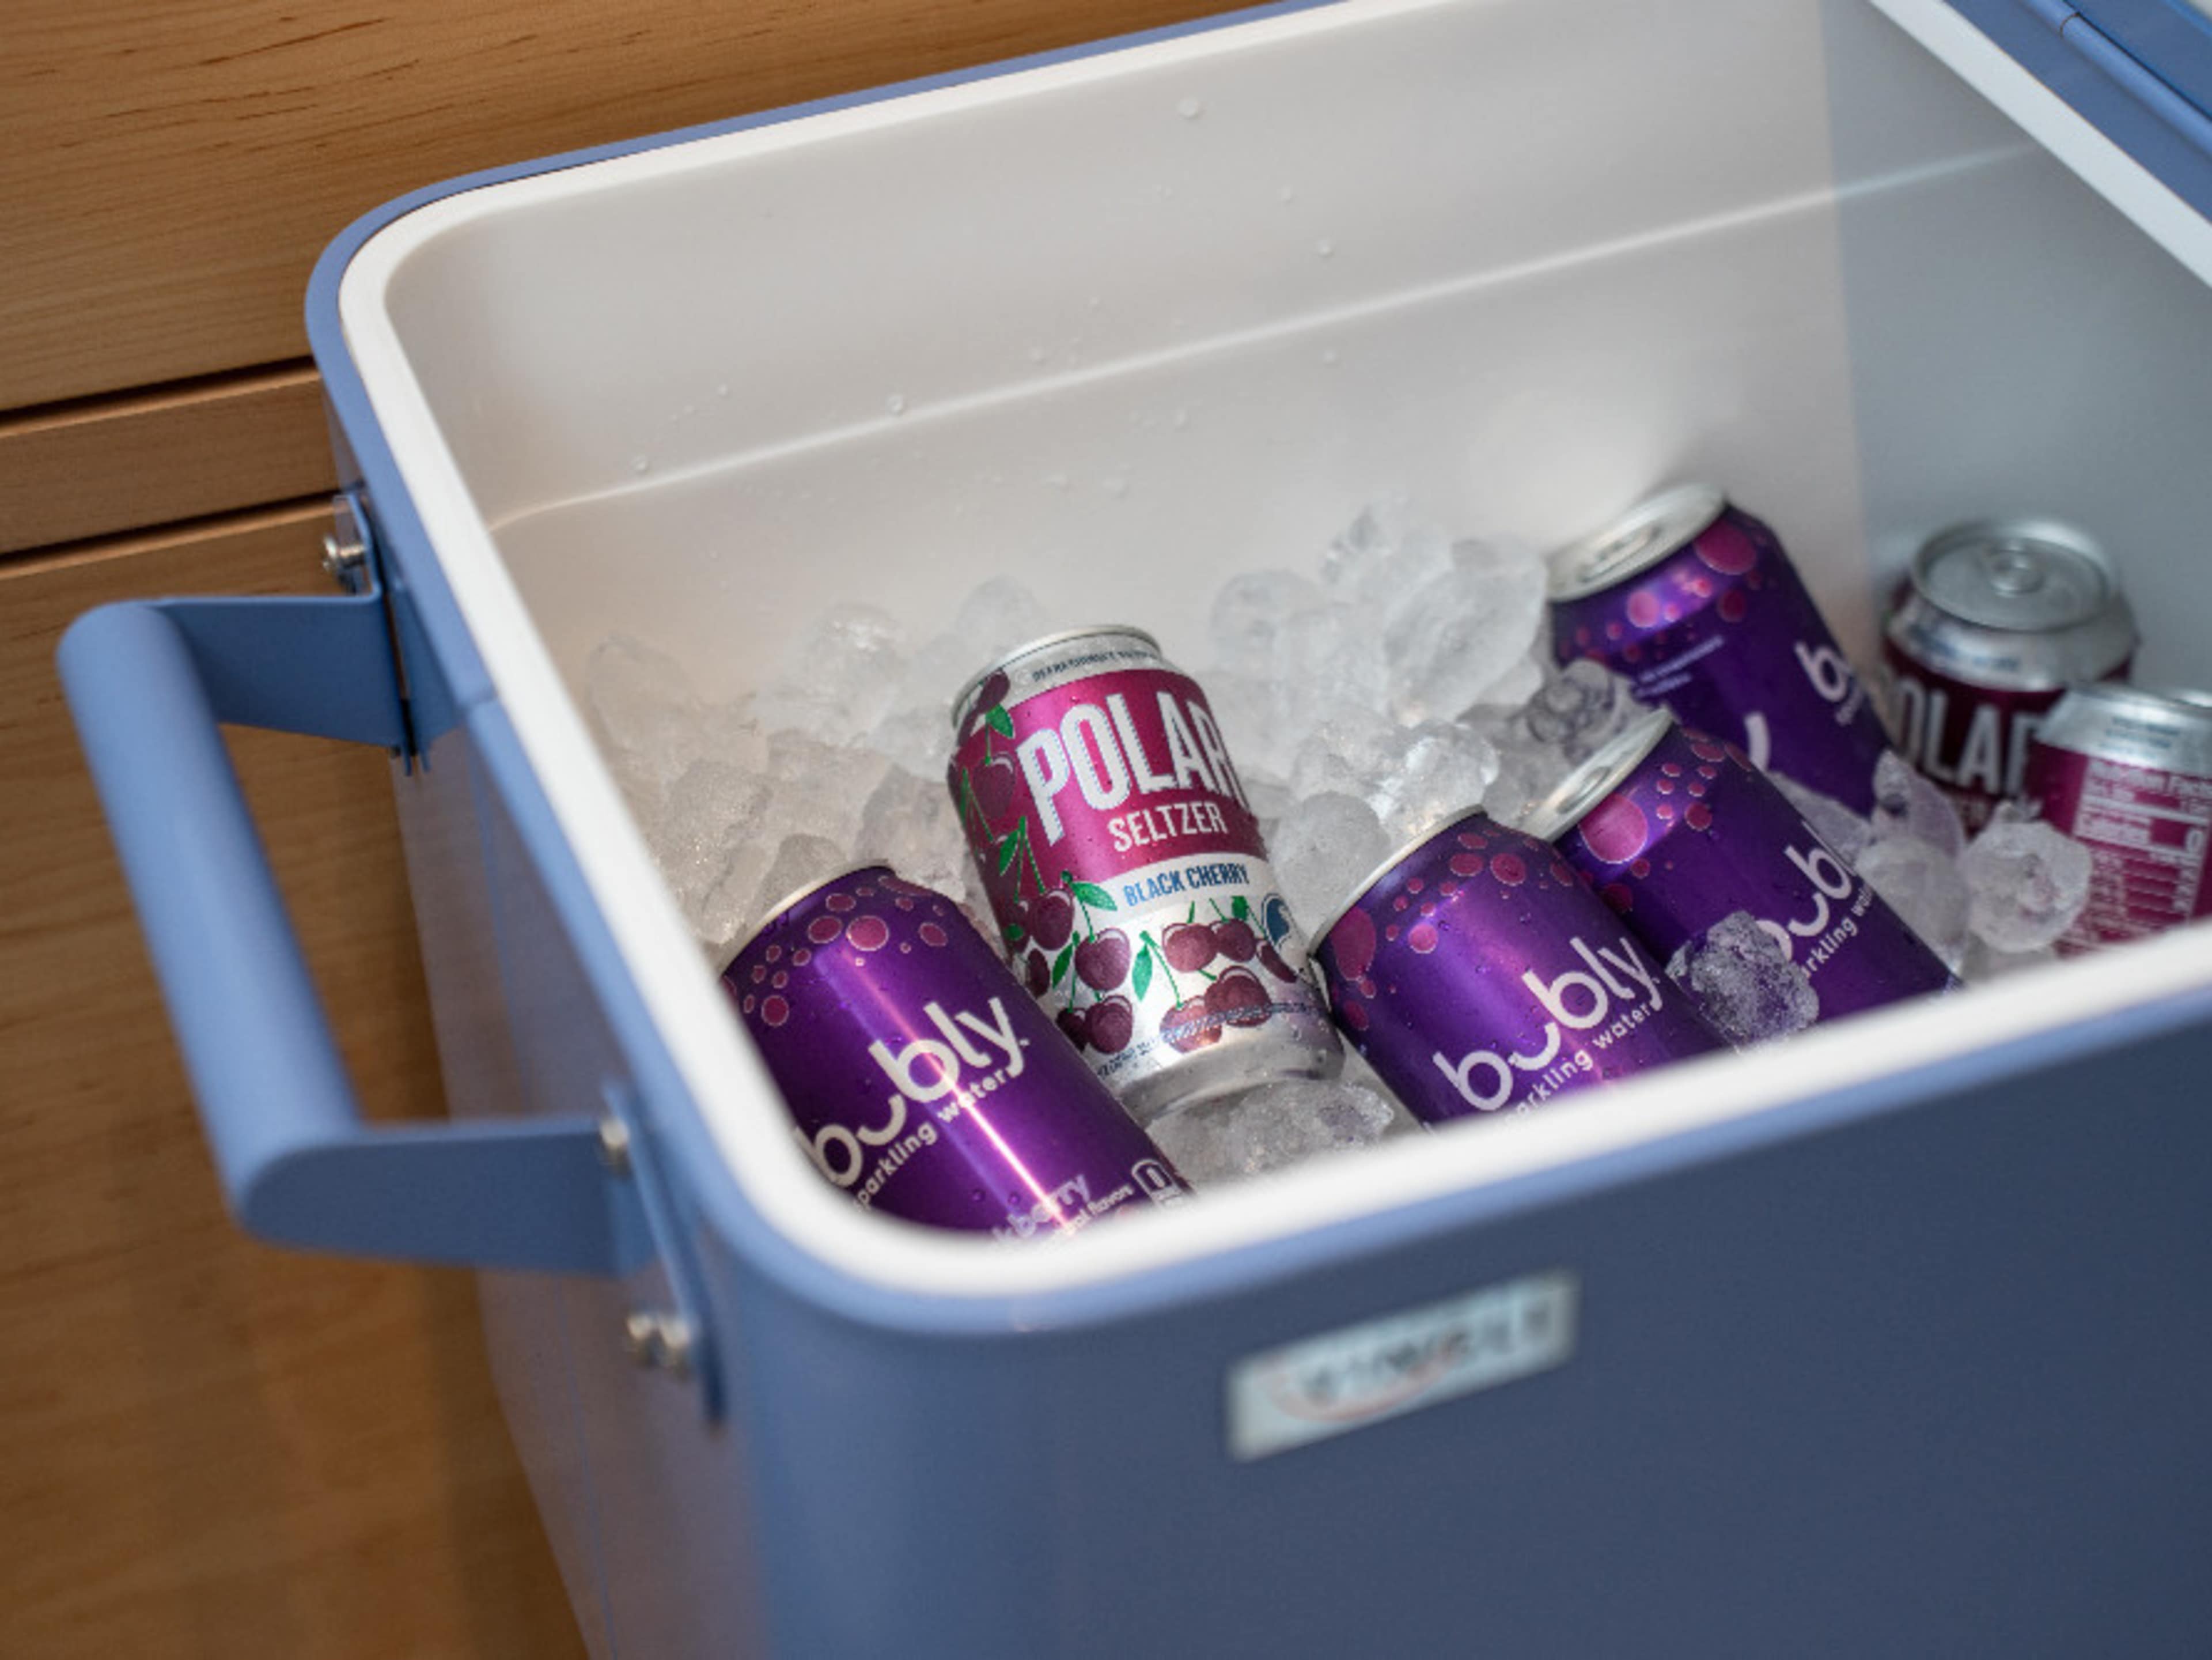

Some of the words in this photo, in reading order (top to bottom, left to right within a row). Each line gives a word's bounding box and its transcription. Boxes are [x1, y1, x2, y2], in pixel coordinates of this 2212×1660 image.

[1014, 691, 1249, 847] POLAR
[1108, 800, 1228, 853] SELTZER
[1124, 868, 1183, 907] BLACK
[1186, 863, 1250, 890] CHERRY
[1433, 937, 1662, 1111] bubly
[1592, 1002, 1651, 1049] water
[796, 997, 1025, 1189] bubly
[937, 1069, 1008, 1124] water
